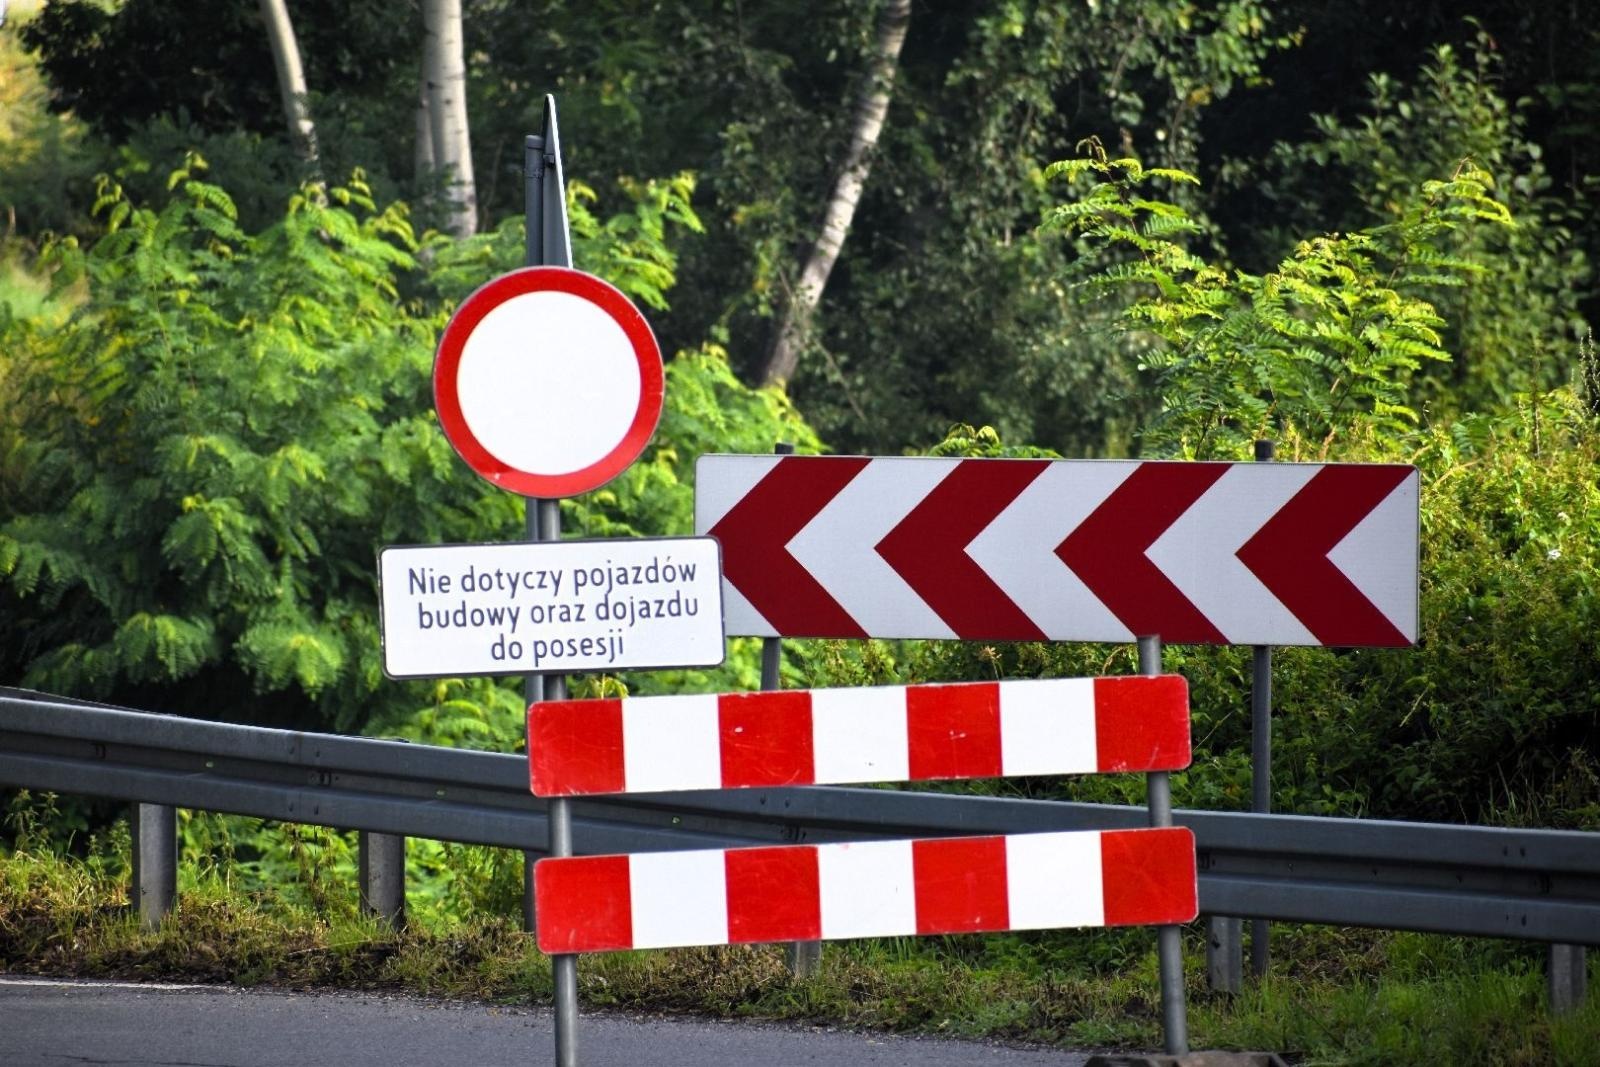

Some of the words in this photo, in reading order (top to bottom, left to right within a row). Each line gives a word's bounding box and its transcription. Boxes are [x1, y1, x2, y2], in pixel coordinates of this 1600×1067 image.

[409, 568, 451, 595] Nie
[461, 565, 563, 598] dotyczy
[574, 556, 697, 595] pojazdów
[418, 600, 521, 634] budowy
[531, 603, 586, 625] oraz
[595, 590, 698, 627] dojazdu
[491, 633, 523, 660] do
[533, 629, 624, 667] posesji
